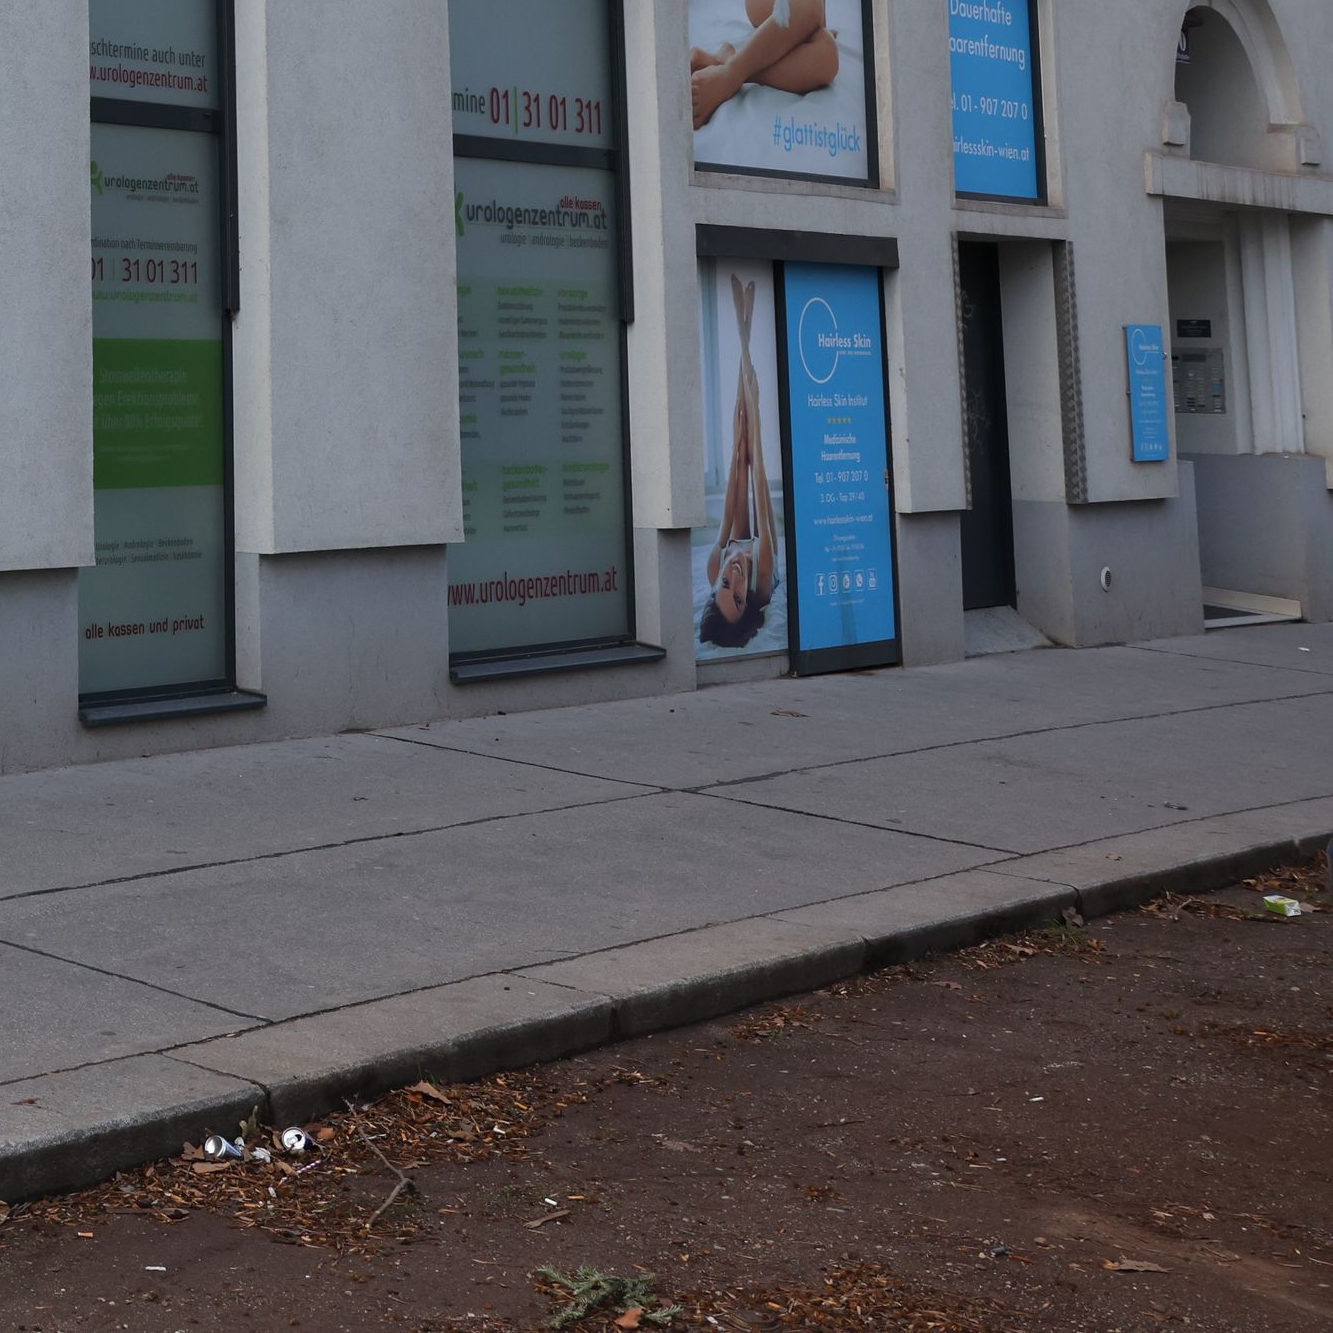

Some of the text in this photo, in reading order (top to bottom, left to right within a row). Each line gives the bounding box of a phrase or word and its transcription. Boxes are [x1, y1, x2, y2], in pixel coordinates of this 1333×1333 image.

[90, 38, 206, 68] schtermine auch unter
[490, 87, 510, 125] 01
[522, 91, 541, 128] 31
[548, 94, 567, 131] 01
[575, 97, 602, 135] 311
[960, 94, 972, 113] 01
[979, 96, 997, 115] 907
[1000, 99, 1019, 118] 207
[1021, 103, 1028, 121] 0
[773, 115, 861, 157] #glattistglück
[104, 174, 199, 193] urologenzentrum.at
[466, 199, 608, 230] urologenzentrum.at
[560, 195, 602, 211] alle kassen
[122, 257, 140, 282] 31
[146, 259, 164, 283] 01
[170, 260, 198, 285] 311
[818, 332, 872, 348] Hairless Skin
[808, 393, 868, 407] Hairless Skin Institut
[837, 471, 850, 483] 907
[851, 470, 863, 483] 207
[85, 614, 205, 640] alle kassen und privat
